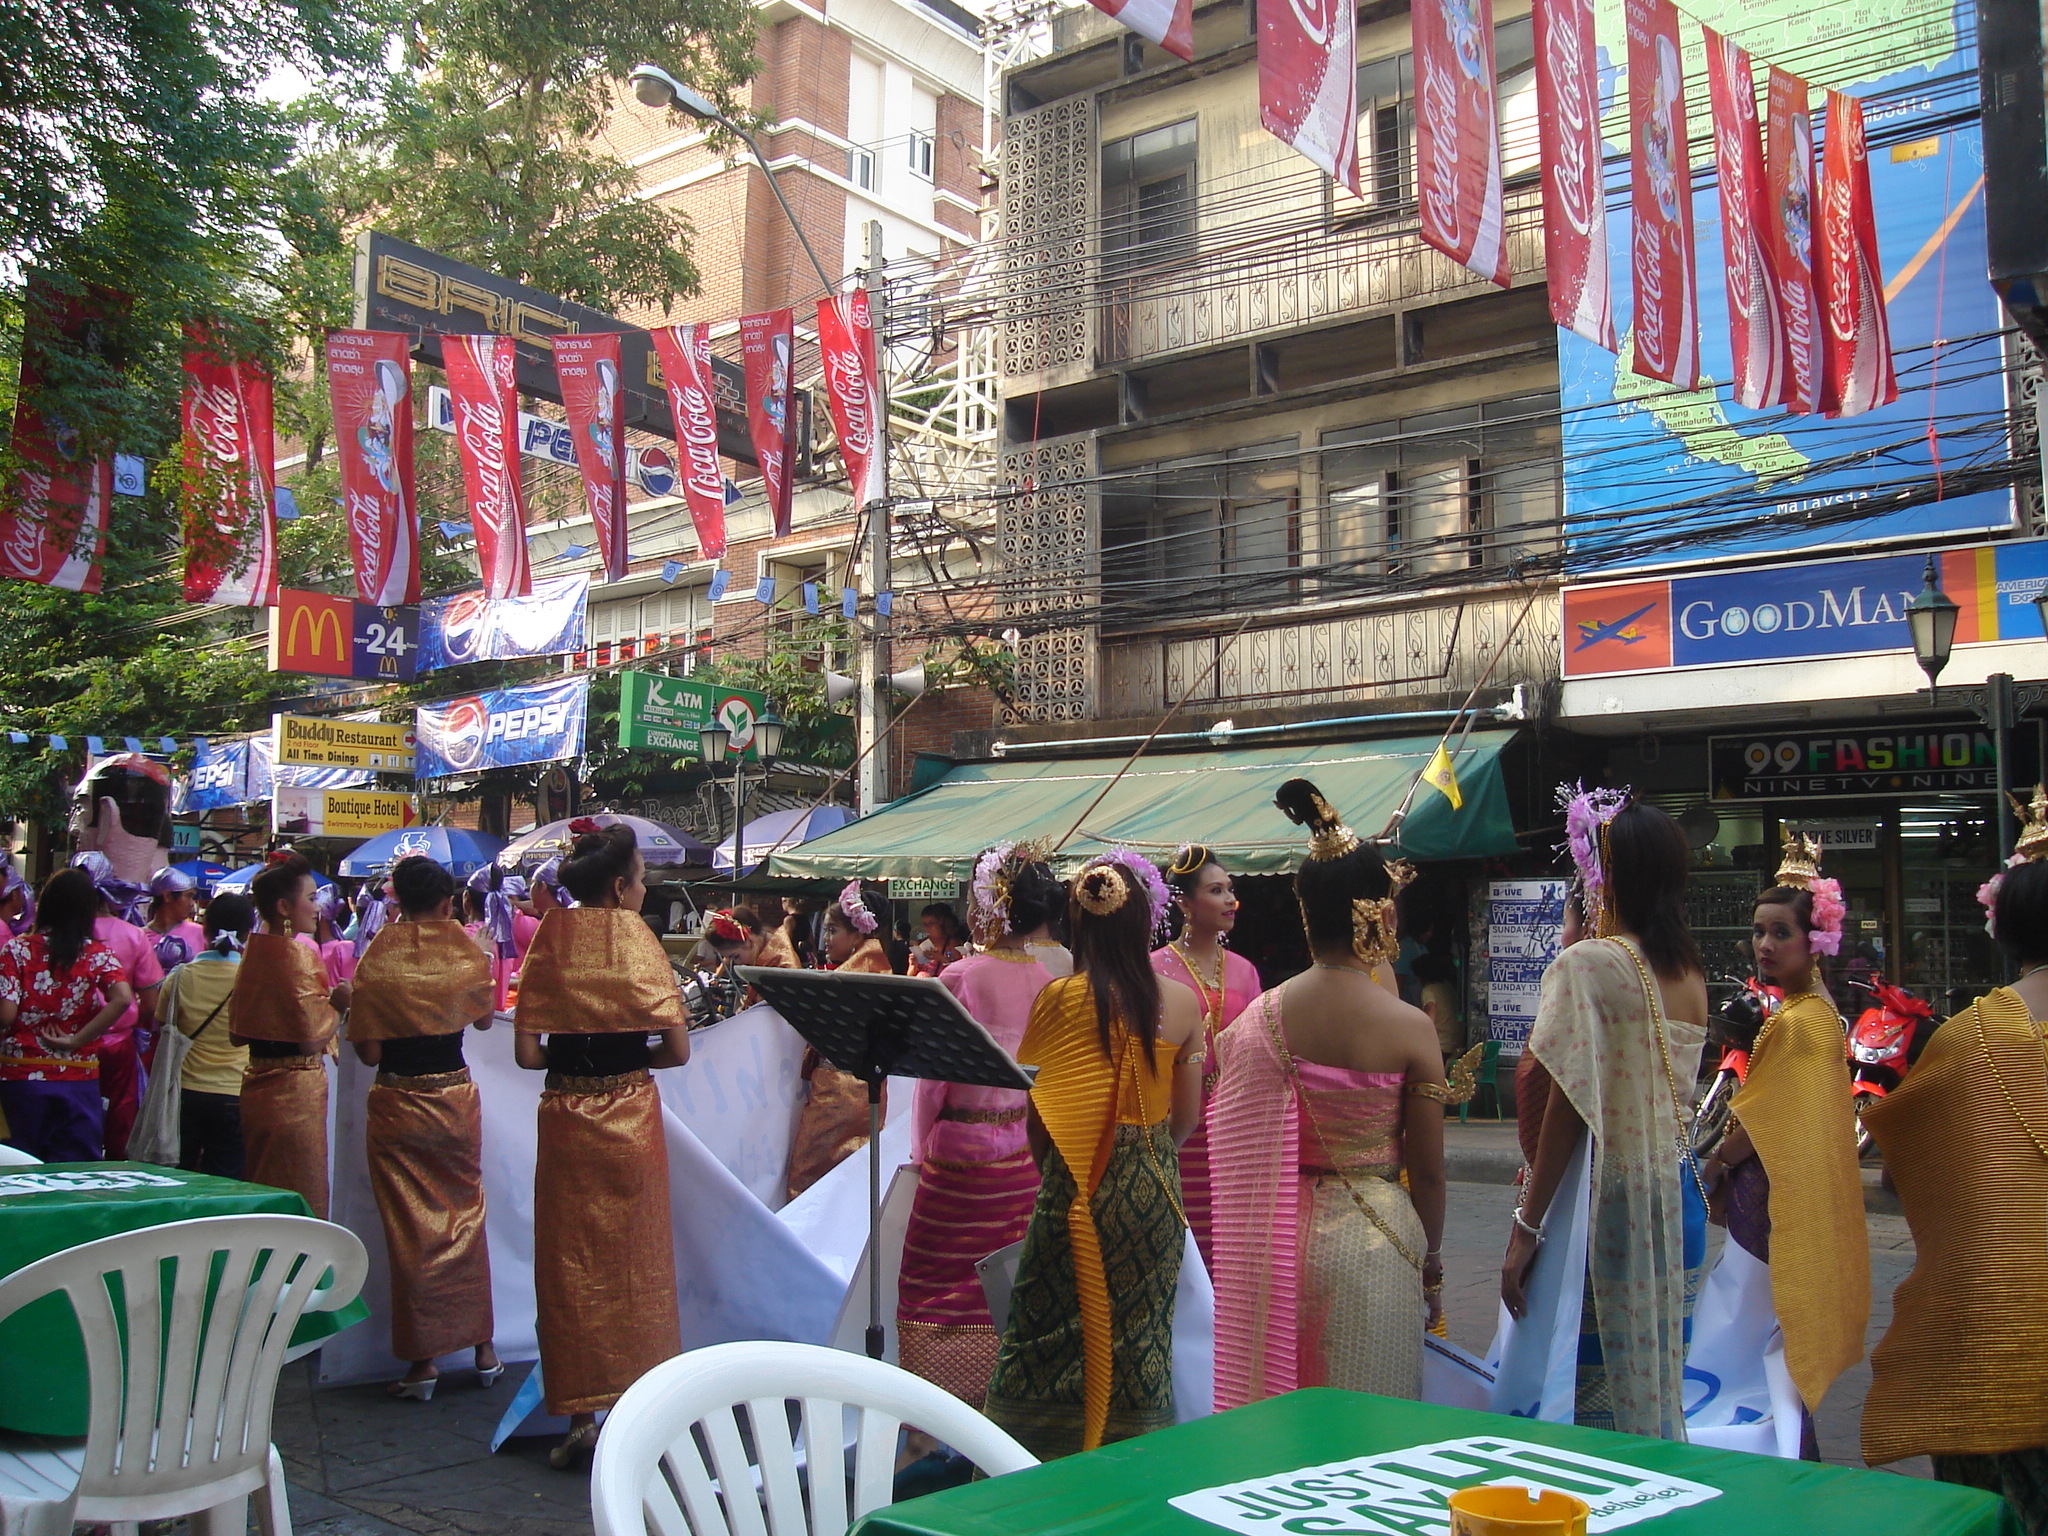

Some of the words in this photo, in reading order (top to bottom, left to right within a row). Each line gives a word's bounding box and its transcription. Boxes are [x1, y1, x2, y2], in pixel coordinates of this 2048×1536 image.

[1787, 16, 1811, 28] Kaen
[1816, 22, 1842, 33] Maha
[1916, 24, 1944, 36] Ubon
[1744, 37, 1775, 50] Chaiya
[1806, 26, 1853, 44] Sarakham
[1544, 0, 1589, 236] Coca-Cola
[1423, 45, 1461, 249] Coca-Cola
[1715, 112, 1750, 319] Coca-Cola
[1823, 168, 1854, 343] Coca-Cola
[1634, 206, 1665, 374] Coca-Cola
[376, 254, 582, 352] BRIC
[828, 348, 869, 456] Coca-Cola
[1664, 409, 1689, 420] Trang
[671, 379, 724, 500] Coca-Cola
[1758, 441, 1788, 451] Pattan
[189, 372, 240, 535] -Cola
[458, 393, 504, 536] Coca-Cola
[1722, 451, 1743, 459] Khla
[1765, 460, 1777, 468] La
[350, 487, 381, 600] Coca-Cola
[366, 623, 407, 656] 24
[673, 691, 703, 710] ATM
[286, 719, 335, 746] Buddy
[336, 729, 398, 748] Restaurant
[486, 703, 572, 745] PEPSI
[647, 735, 699, 751] EXCHANGE
[286, 748, 300, 760] All
[303, 750, 324, 761] Time
[327, 752, 360, 766] Dinings
[1744, 740, 1801, 774] 99
[1744, 776, 1881, 793] NINETY
[1912, 771, 1998, 788] NINE
[328, 797, 371, 819] Boutique
[373, 799, 400, 816] Hotel
[327, 820, 362, 832] Swimming
[364, 821, 379, 830] Pool
[386, 822, 400, 831] Spa
[1835, 828, 1873, 844] SILVER
[892, 880, 956, 891] EXCHANGE
[1492, 983, 1526, 991] SUNDAY
[1502, 1042, 1525, 1050] NDAY
[1218, 1469, 1405, 1520] JUST
